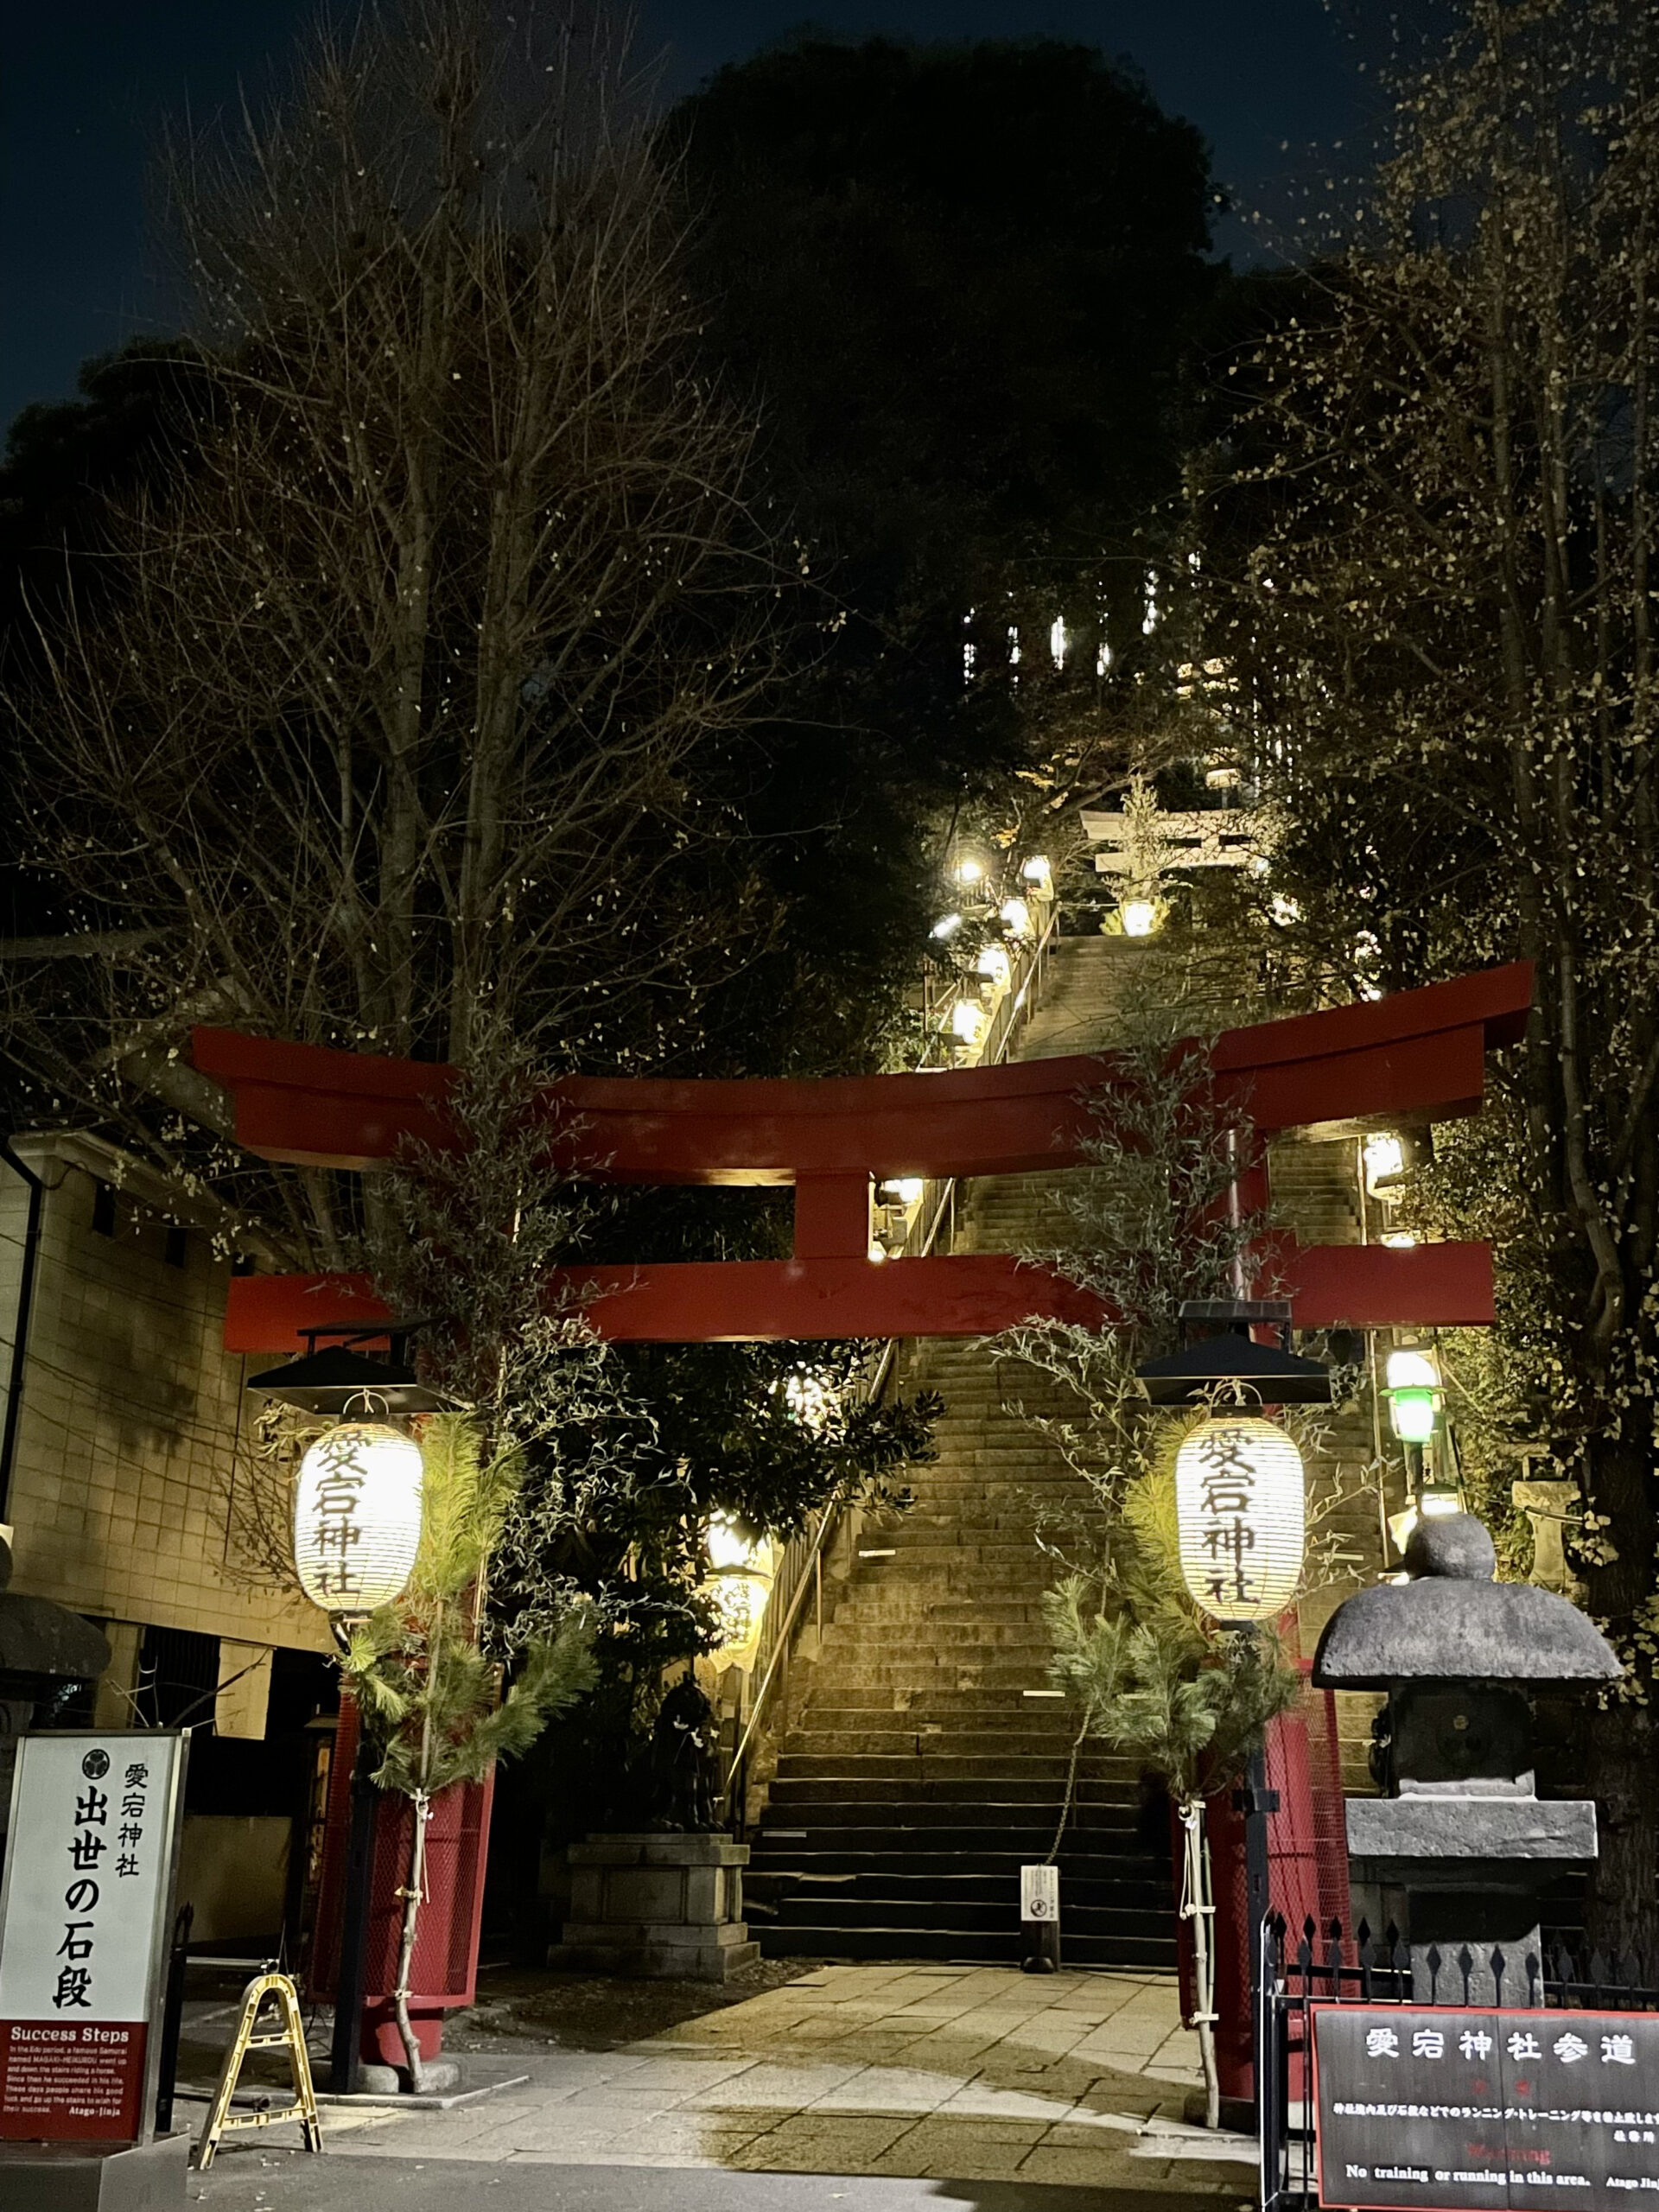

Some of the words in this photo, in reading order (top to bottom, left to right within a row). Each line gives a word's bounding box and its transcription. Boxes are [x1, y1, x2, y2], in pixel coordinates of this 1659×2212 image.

[312, 1429, 372, 1597] 愛宕神社
[1198, 1427, 1261, 1605] 愛宕神社
[115, 1763, 149, 1878] 愛宕神社
[52, 1784, 108, 2008] 出世の石段
[11, 2026, 76, 2041] Success
[82, 2027, 129, 2044] Steps
[1365, 2027, 1637, 2065] 愛宕神社参道
[1345, 2164, 1368, 2178] No
[1374, 2166, 1429, 2183] training
[1434, 2171, 1451, 2181] or
[1453, 2169, 1507, 2185] running
[1510, 2170, 1524, 2183] in
[1527, 2171, 1554, 2184] this
[1556, 2174, 1591, 2186] area.
[1605, 2177, 1638, 2190] Atago
